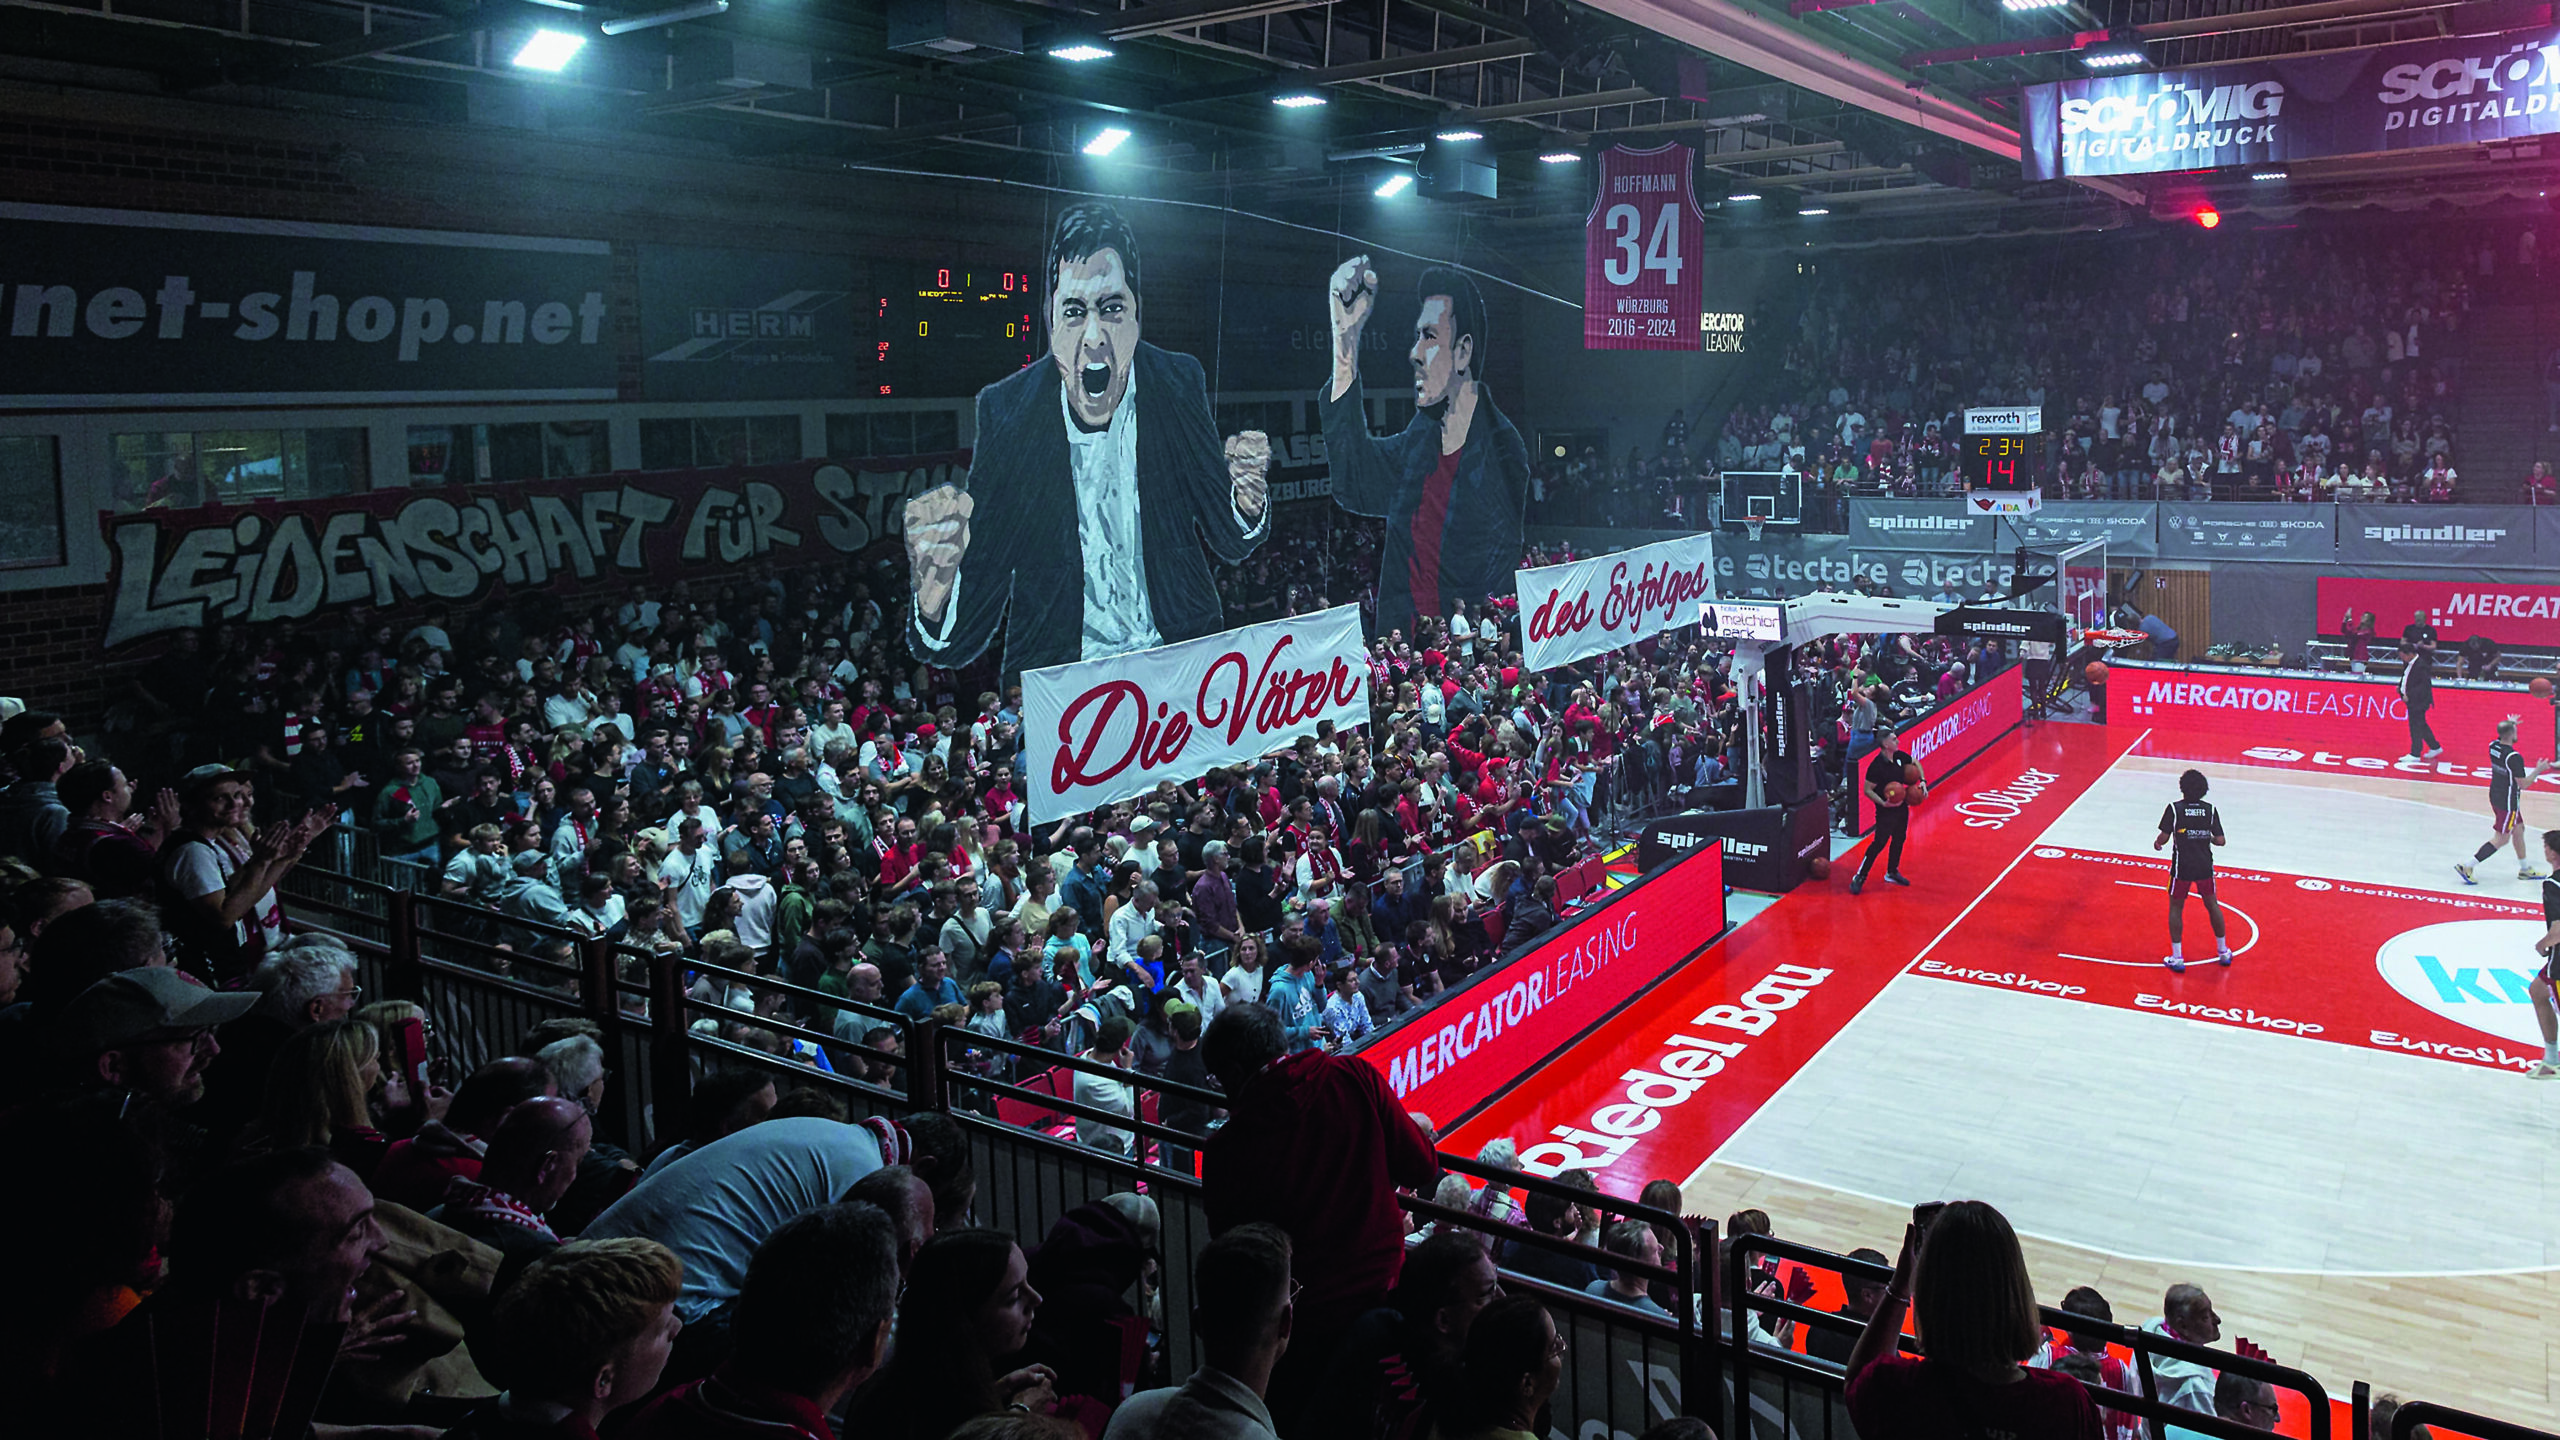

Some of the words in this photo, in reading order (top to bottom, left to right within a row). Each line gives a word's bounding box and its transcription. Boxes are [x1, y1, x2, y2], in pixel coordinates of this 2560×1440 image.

[2062, 124, 2276, 157] DIGITALDRUCK
[1614, 174, 1676, 193] HOFFMANN
[1604, 203, 1682, 286] 34
[1616, 296, 1668, 314] WÜRZBURG
[694, 311, 812, 337] HERM
[1608, 319, 1635, 336] 2016
[1647, 319, 1676, 336] 2024
[1971, 412, 2020, 423] rexroth
[1986, 460, 2015, 484] 14
[1868, 515, 1974, 530] spindler
[2364, 524, 2506, 541] spindler
[1529, 588, 1594, 642] des
[1600, 561, 1709, 634] Erfolges
[1722, 612, 1779, 628] melchior
[1963, 621, 2031, 633] spindler
[1723, 627, 1755, 639] park
[1052, 680, 1193, 794] Die
[1197, 635, 1360, 746] Väter
[1657, 832, 1768, 857] spiler
[1520, 1033, 1749, 1180] Riedel
[1690, 963, 1834, 1036] Bau
